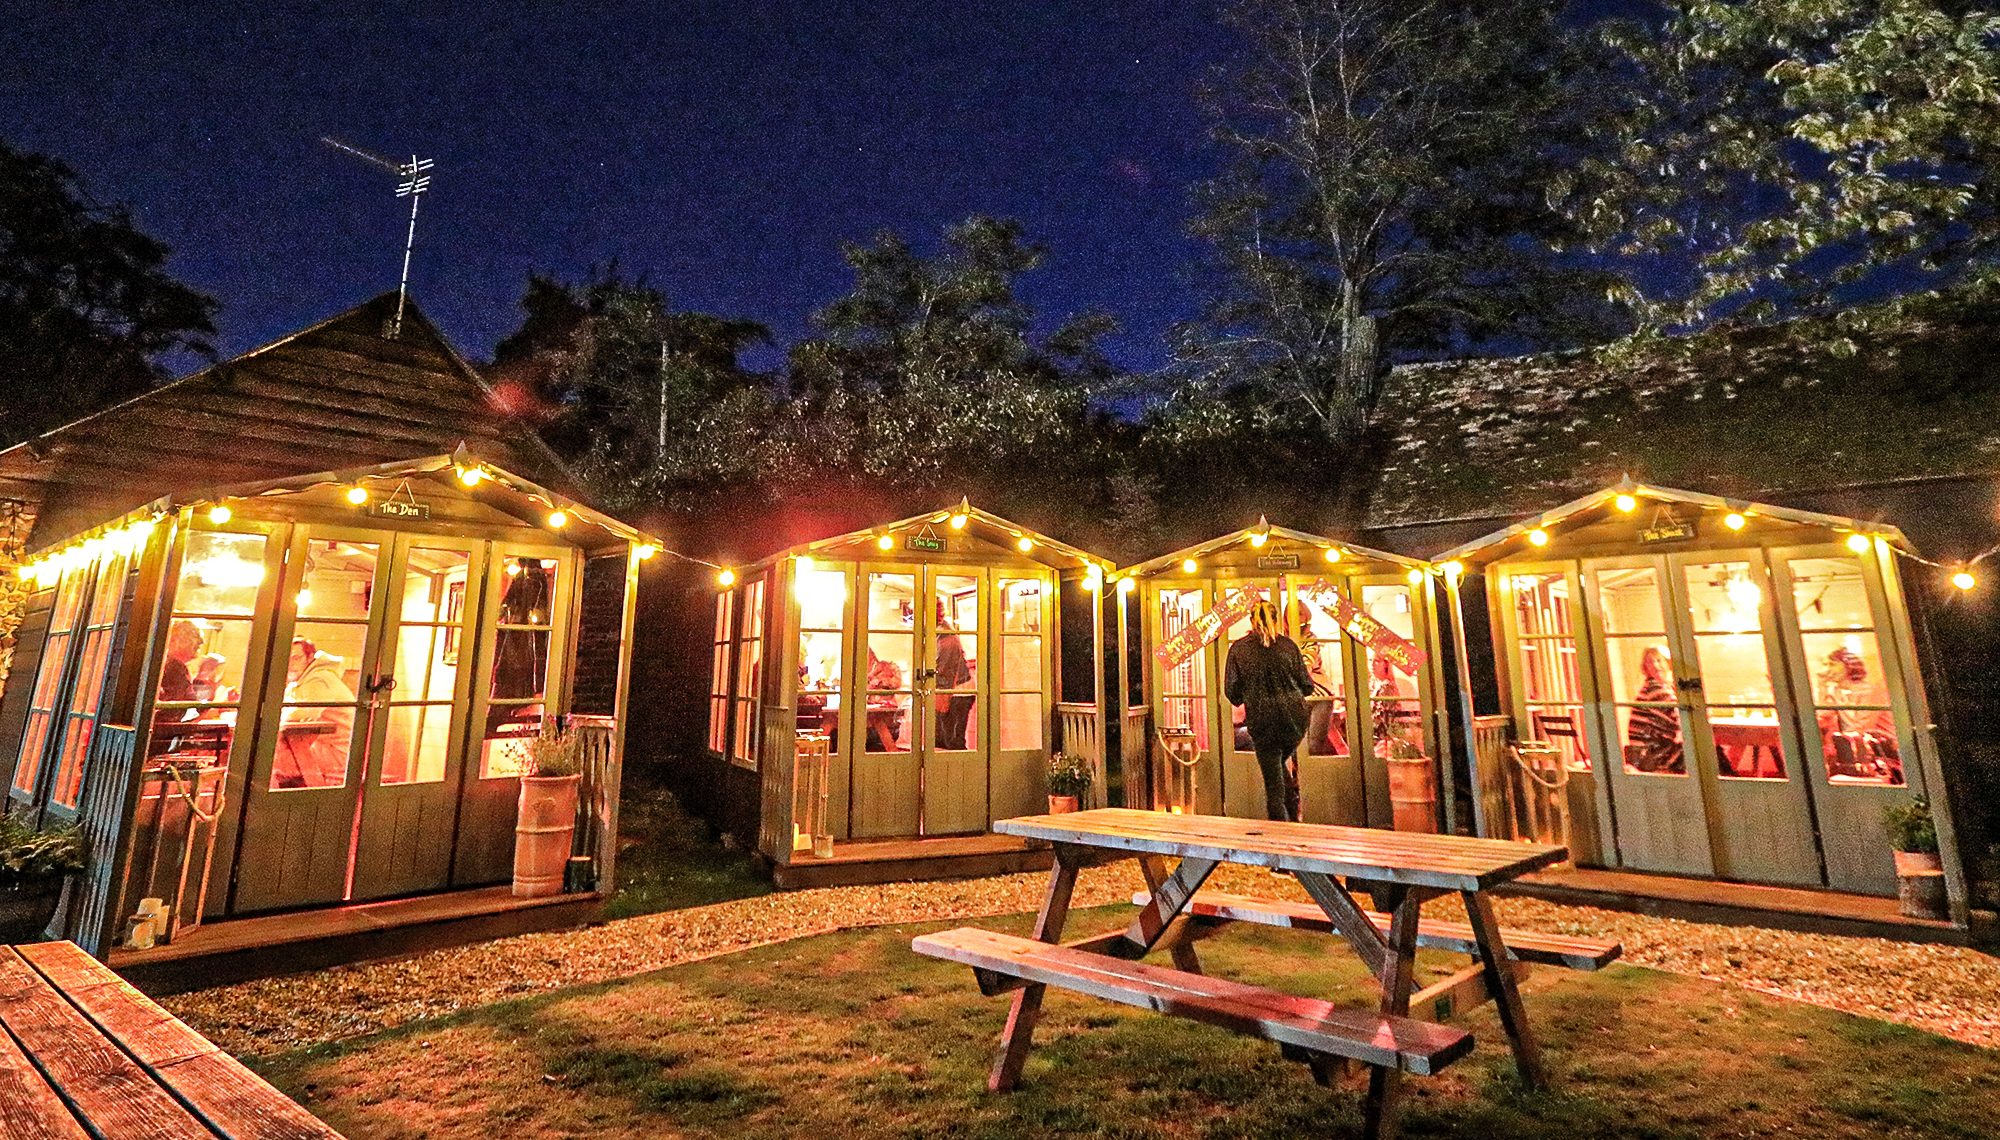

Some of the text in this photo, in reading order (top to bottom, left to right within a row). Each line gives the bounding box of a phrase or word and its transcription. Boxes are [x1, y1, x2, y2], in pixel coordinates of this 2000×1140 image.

[380, 502, 419, 515] The Den
[914, 539, 926, 547] The
